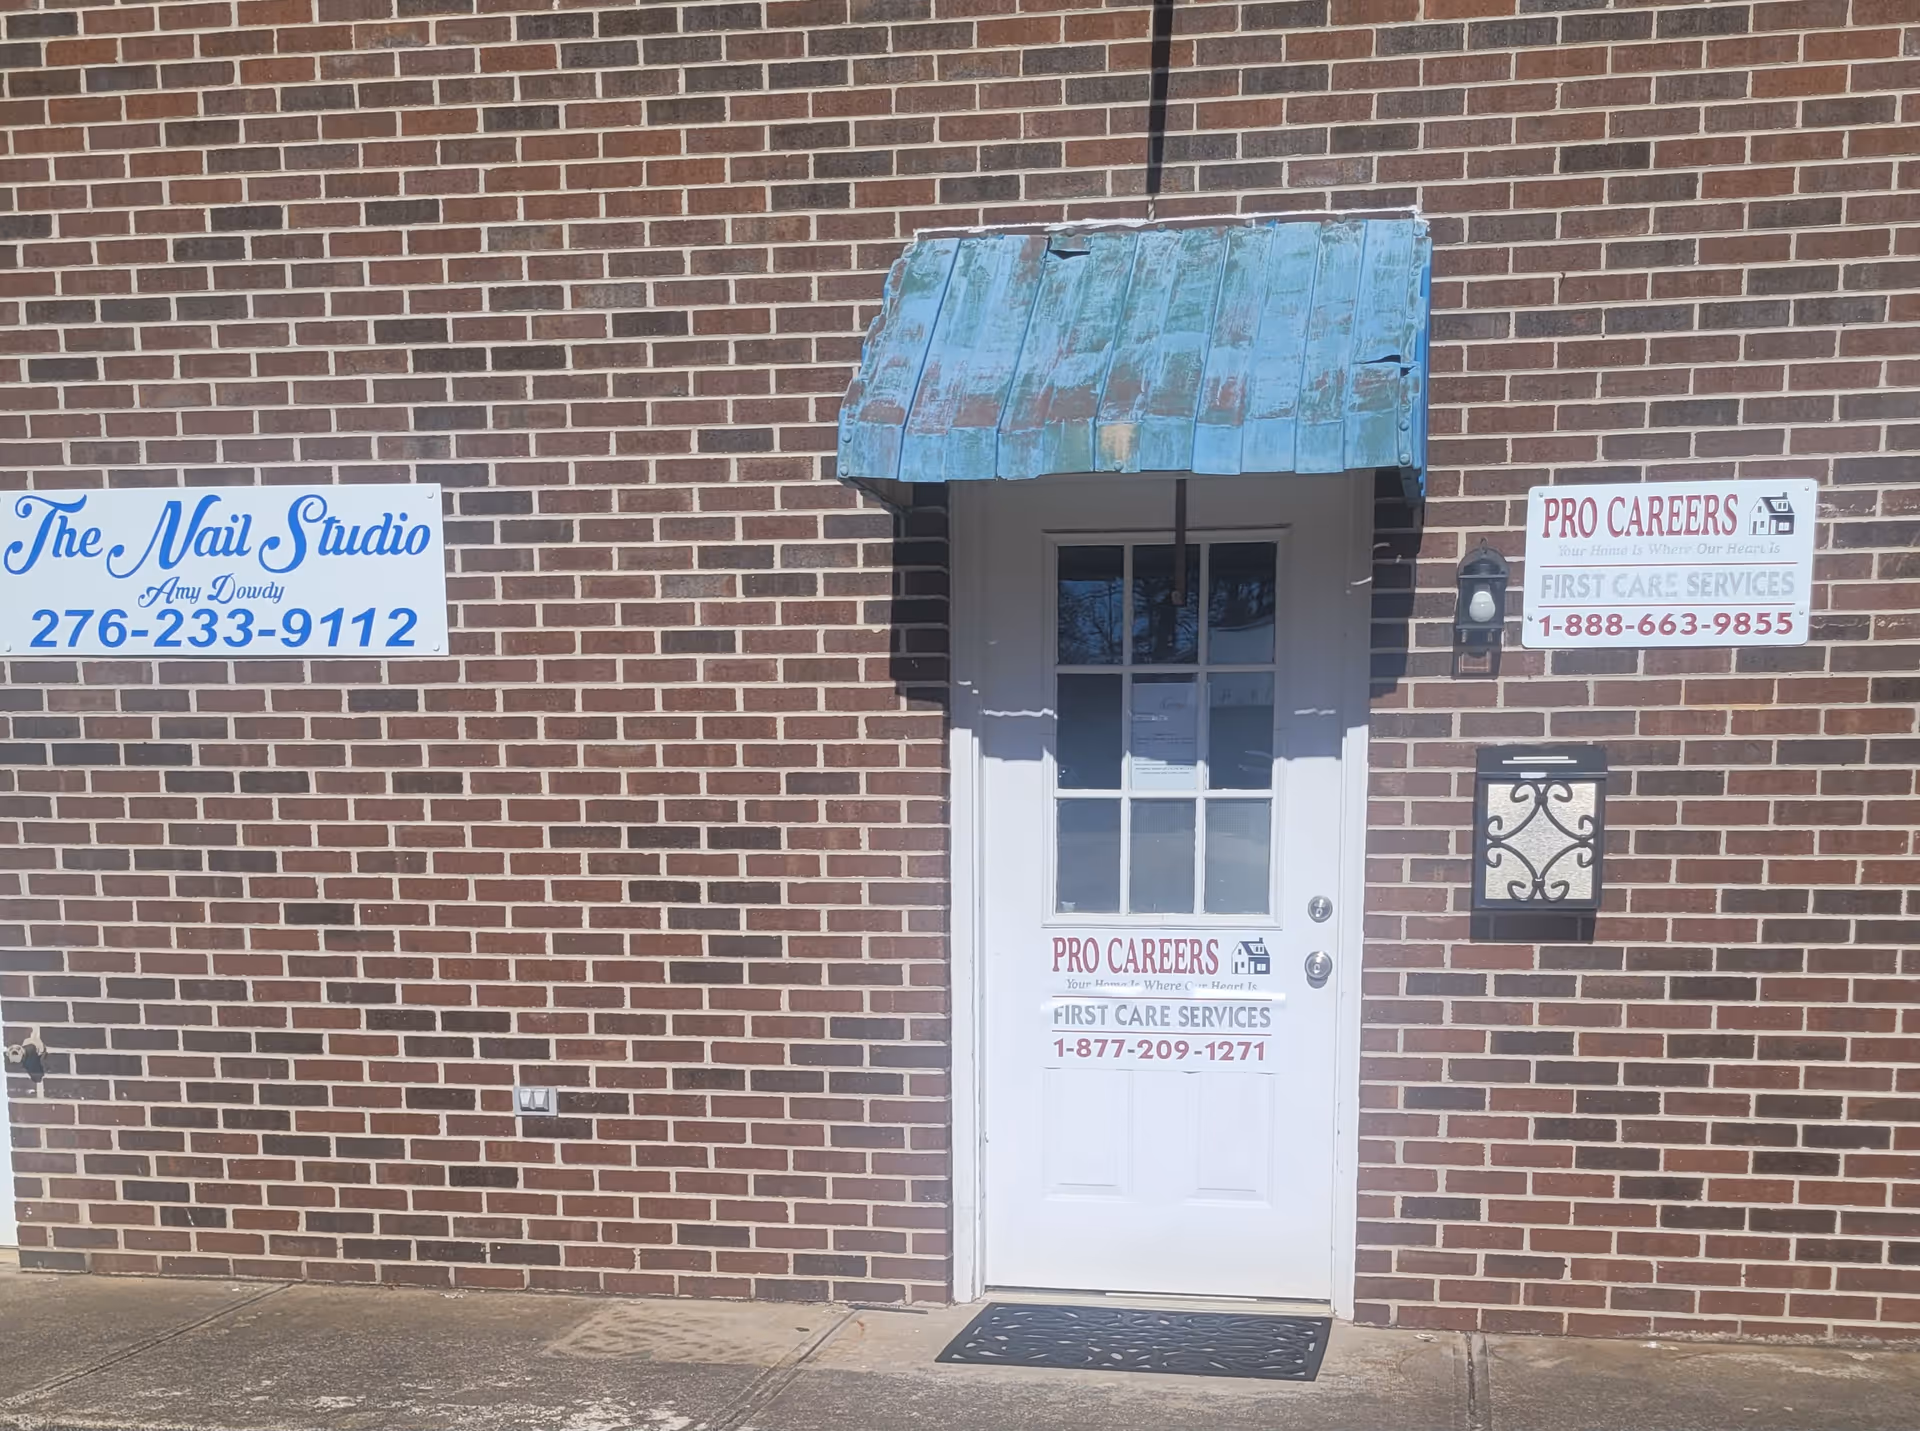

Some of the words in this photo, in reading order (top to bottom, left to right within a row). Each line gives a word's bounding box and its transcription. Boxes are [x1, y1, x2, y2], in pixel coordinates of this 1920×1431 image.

[1542, 497, 1598, 538] PRO
[1607, 494, 1738, 538] CAREERS
[4, 494, 103, 575] The
[106, 494, 251, 579] Nail
[258, 494, 430, 574] Studio
[1558, 543, 1586, 557] Your
[1632, 543, 1643, 556] Is
[1697, 542, 1723, 555] Our
[1769, 540, 1781, 554] Is
[138, 576, 201, 608] Amy
[207, 573, 285, 605] Dowdy
[1540, 573, 1606, 600] FIRST
[1612, 572, 1678, 599] CARE
[1686, 571, 1795, 597] SERVICES
[30, 607, 418, 648] 276-233-9112
[1538, 612, 1793, 637] 1-888-663-9855
[1052, 937, 1100, 974] PRO
[1107, 937, 1219, 975] CAREERS
[1066, 979, 1092, 990] Your
[1144, 979, 1181, 991] Where
[1211, 981, 1243, 991] Heart
[1248, 981, 1257, 991] Is
[1053, 1004, 1108, 1026] FIRST
[1115, 1004, 1170, 1027] CARE
[1178, 1006, 1271, 1029] SERVICES
[1053, 1038, 1265, 1061] 1-877-209-1271
